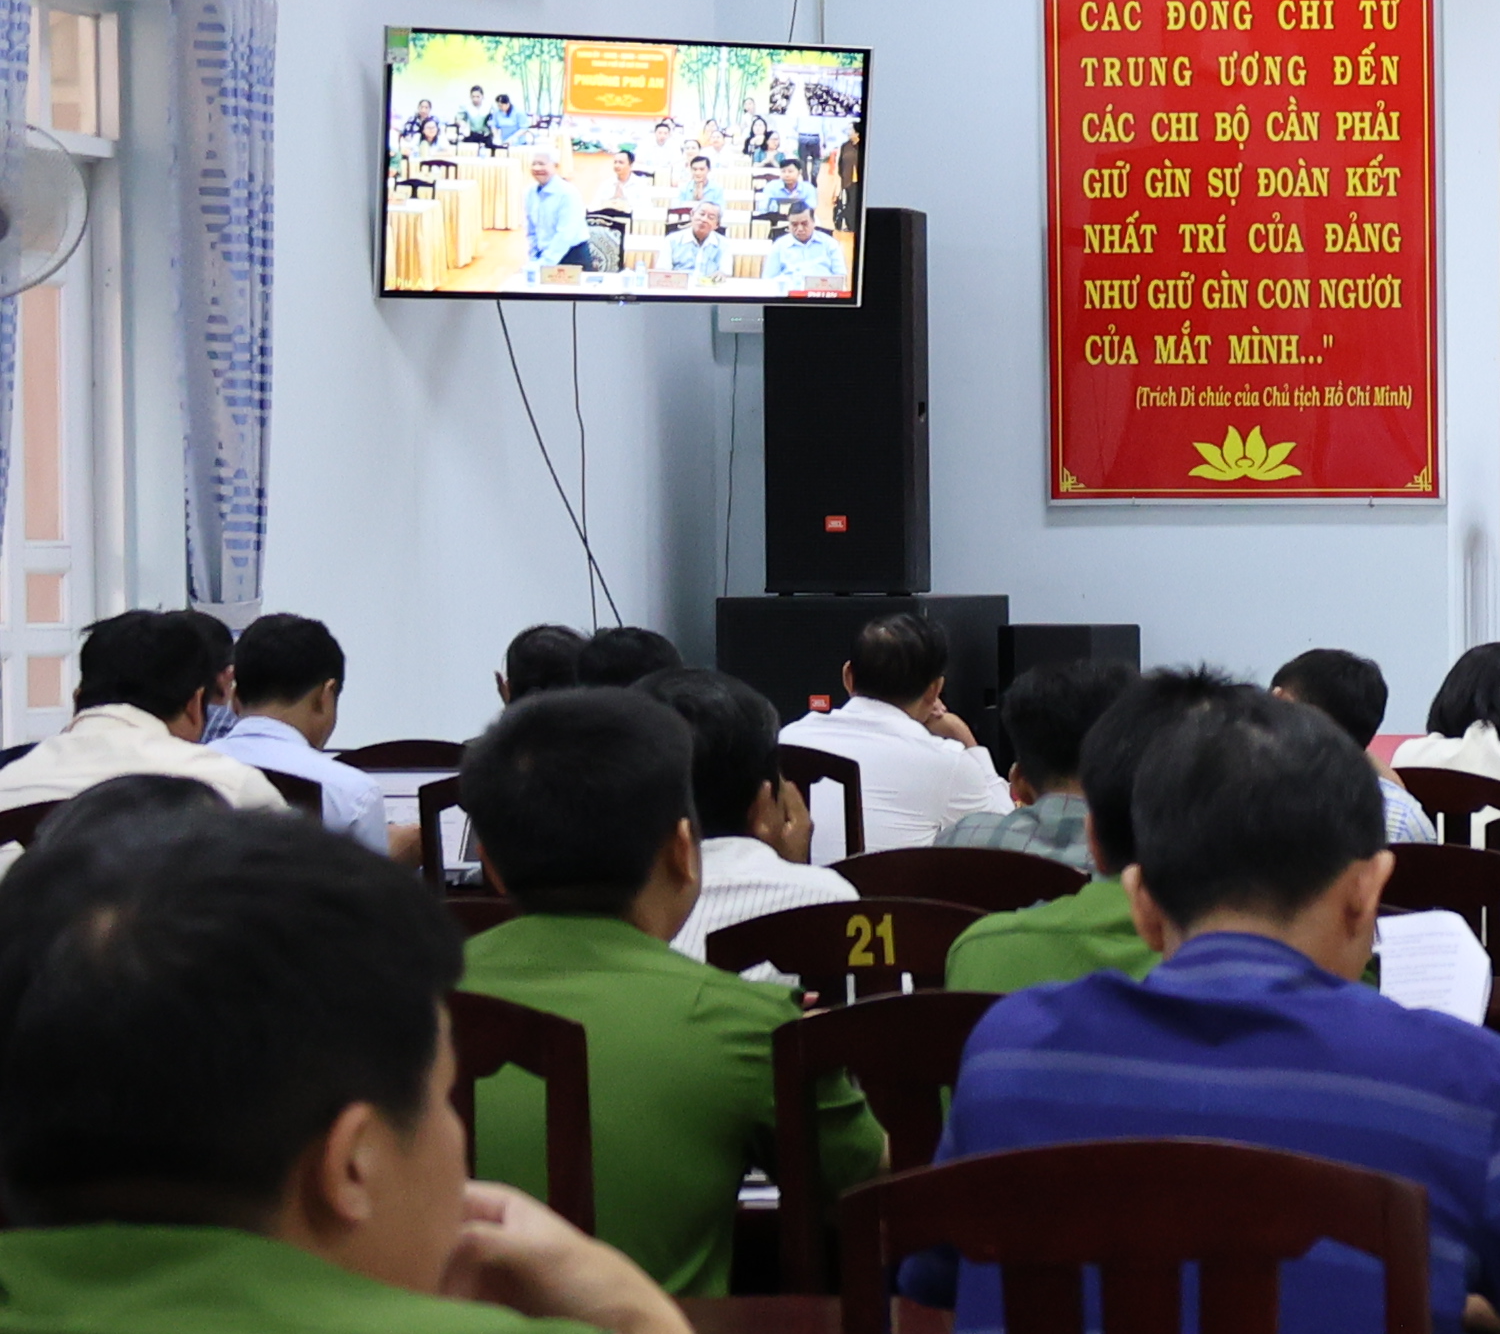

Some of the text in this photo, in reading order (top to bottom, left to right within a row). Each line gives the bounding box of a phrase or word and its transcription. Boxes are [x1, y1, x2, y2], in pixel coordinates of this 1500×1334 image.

[1081, 43, 1399, 86] TRUNG ƯƠNG ĐẾN
[1083, 96, 1400, 149] CÁC CHI BỘ CẦN PHẢI
[1083, 154, 1400, 205] GIỮ GÌN SỰ ĐOÀN KẾT
[1084, 211, 1401, 253] NHẤT TRÍ CỦA ĐẢNG
[1084, 270, 1401, 309] NHƯ GIỮ GÌN CON NGƯƠI
[1085, 324, 1138, 365] CỦA
[1154, 321, 1211, 364] MẮT
[1137, 381, 1411, 411] (Trích Di chúc của Chủ tịch Hồ Chí Minh)
[847, 914, 894, 965] 21
